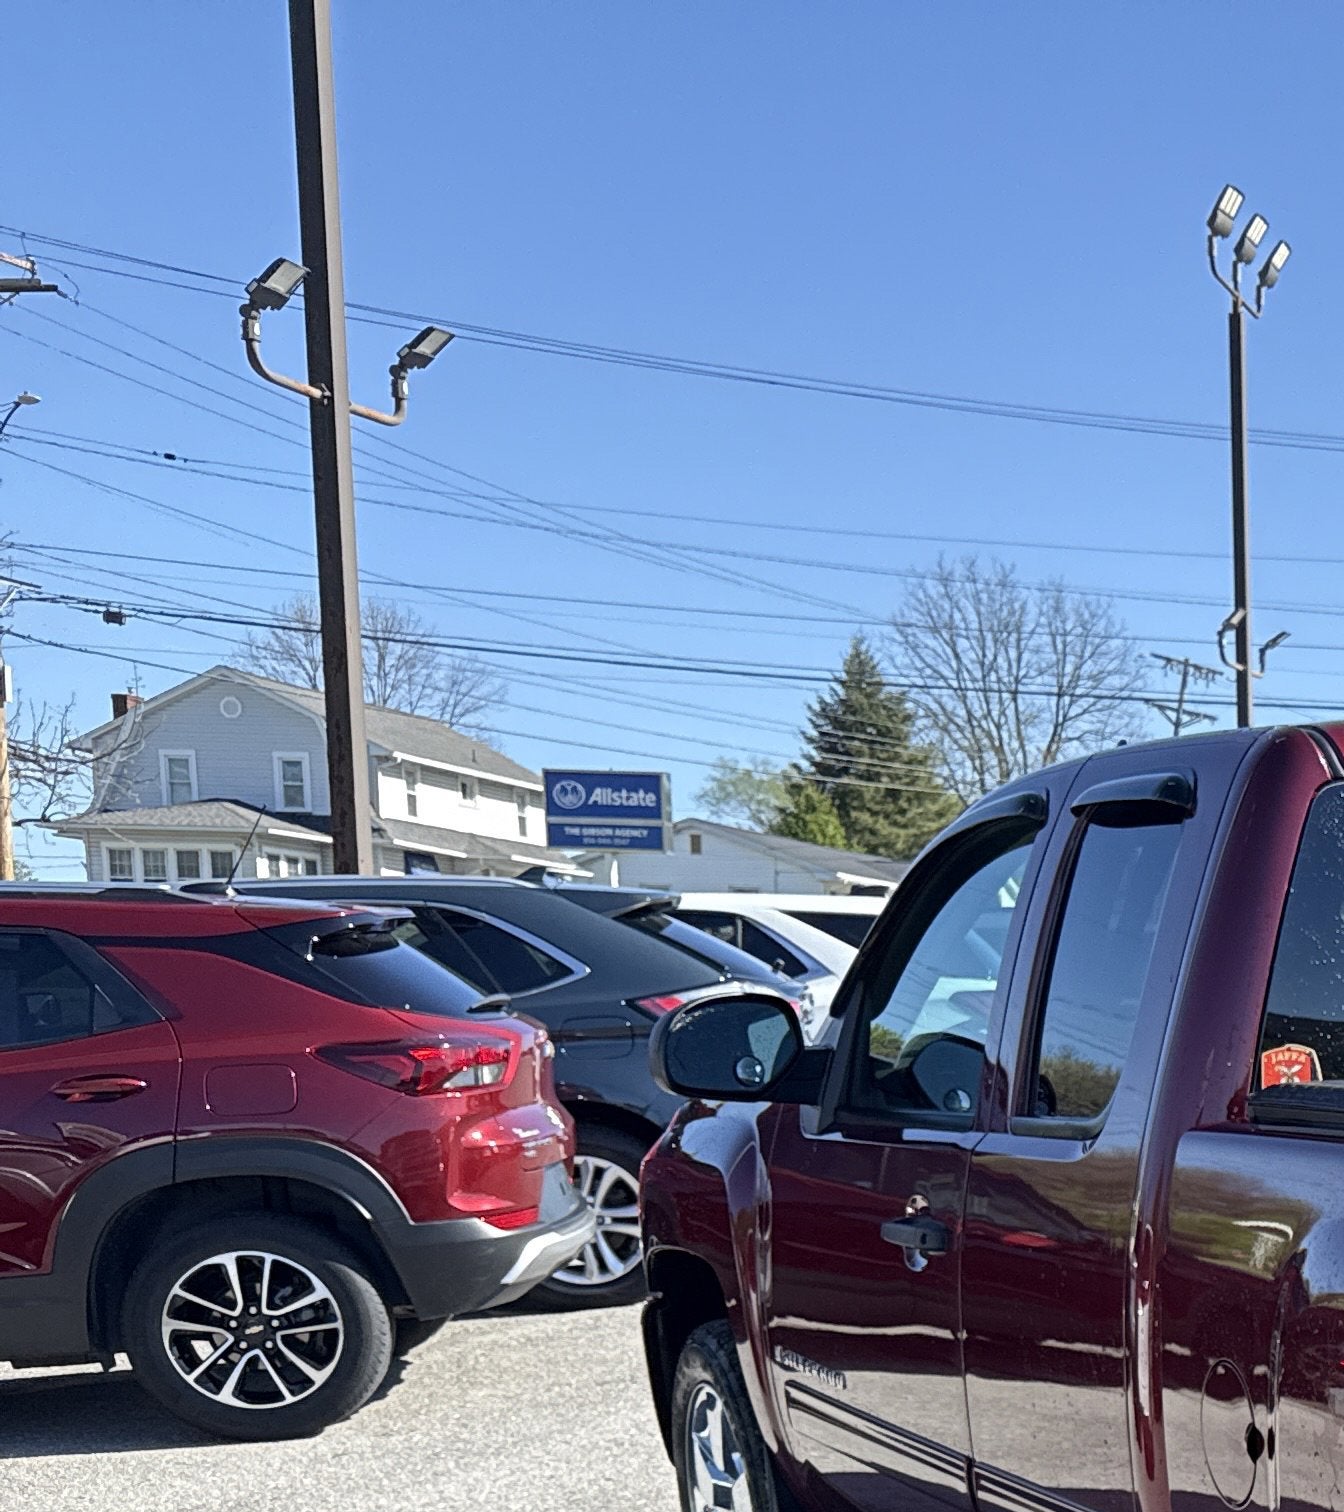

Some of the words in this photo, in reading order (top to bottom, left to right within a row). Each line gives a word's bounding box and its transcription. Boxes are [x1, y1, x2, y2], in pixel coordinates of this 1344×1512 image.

[588, 787, 656, 806] Allstate
[564, 827, 580, 836] THE
[615, 828, 648, 838] AGENCY
